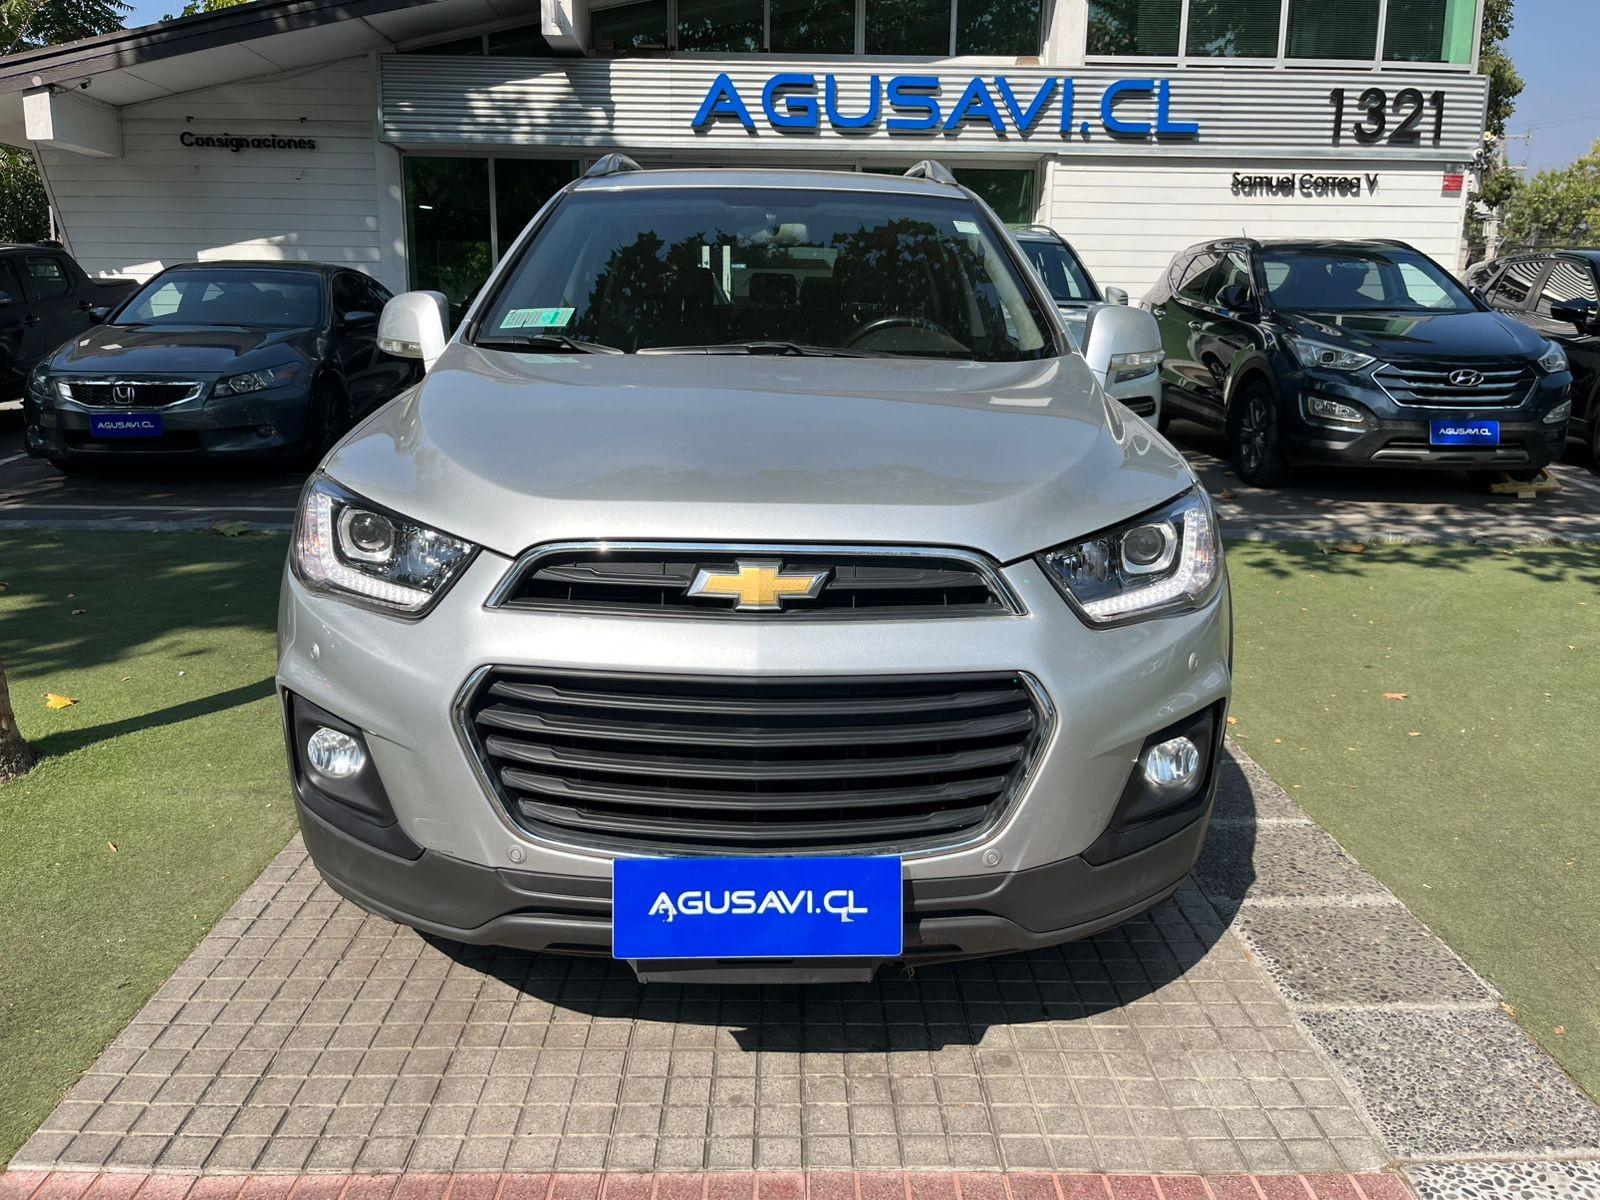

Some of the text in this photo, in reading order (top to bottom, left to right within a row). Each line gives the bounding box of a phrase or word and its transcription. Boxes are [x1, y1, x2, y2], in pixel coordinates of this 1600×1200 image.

[691, 72, 1199, 136] AGUSAVI.CL
[1329, 87, 1445, 148] 1321
[180, 131, 316, 152] Consignaciones
[1231, 172, 1296, 191] Samuel
[1299, 173, 1361, 192] Correa
[97, 421, 155, 429] AGUSAVI.CL
[648, 889, 868, 917] AGUSAVI.CL
